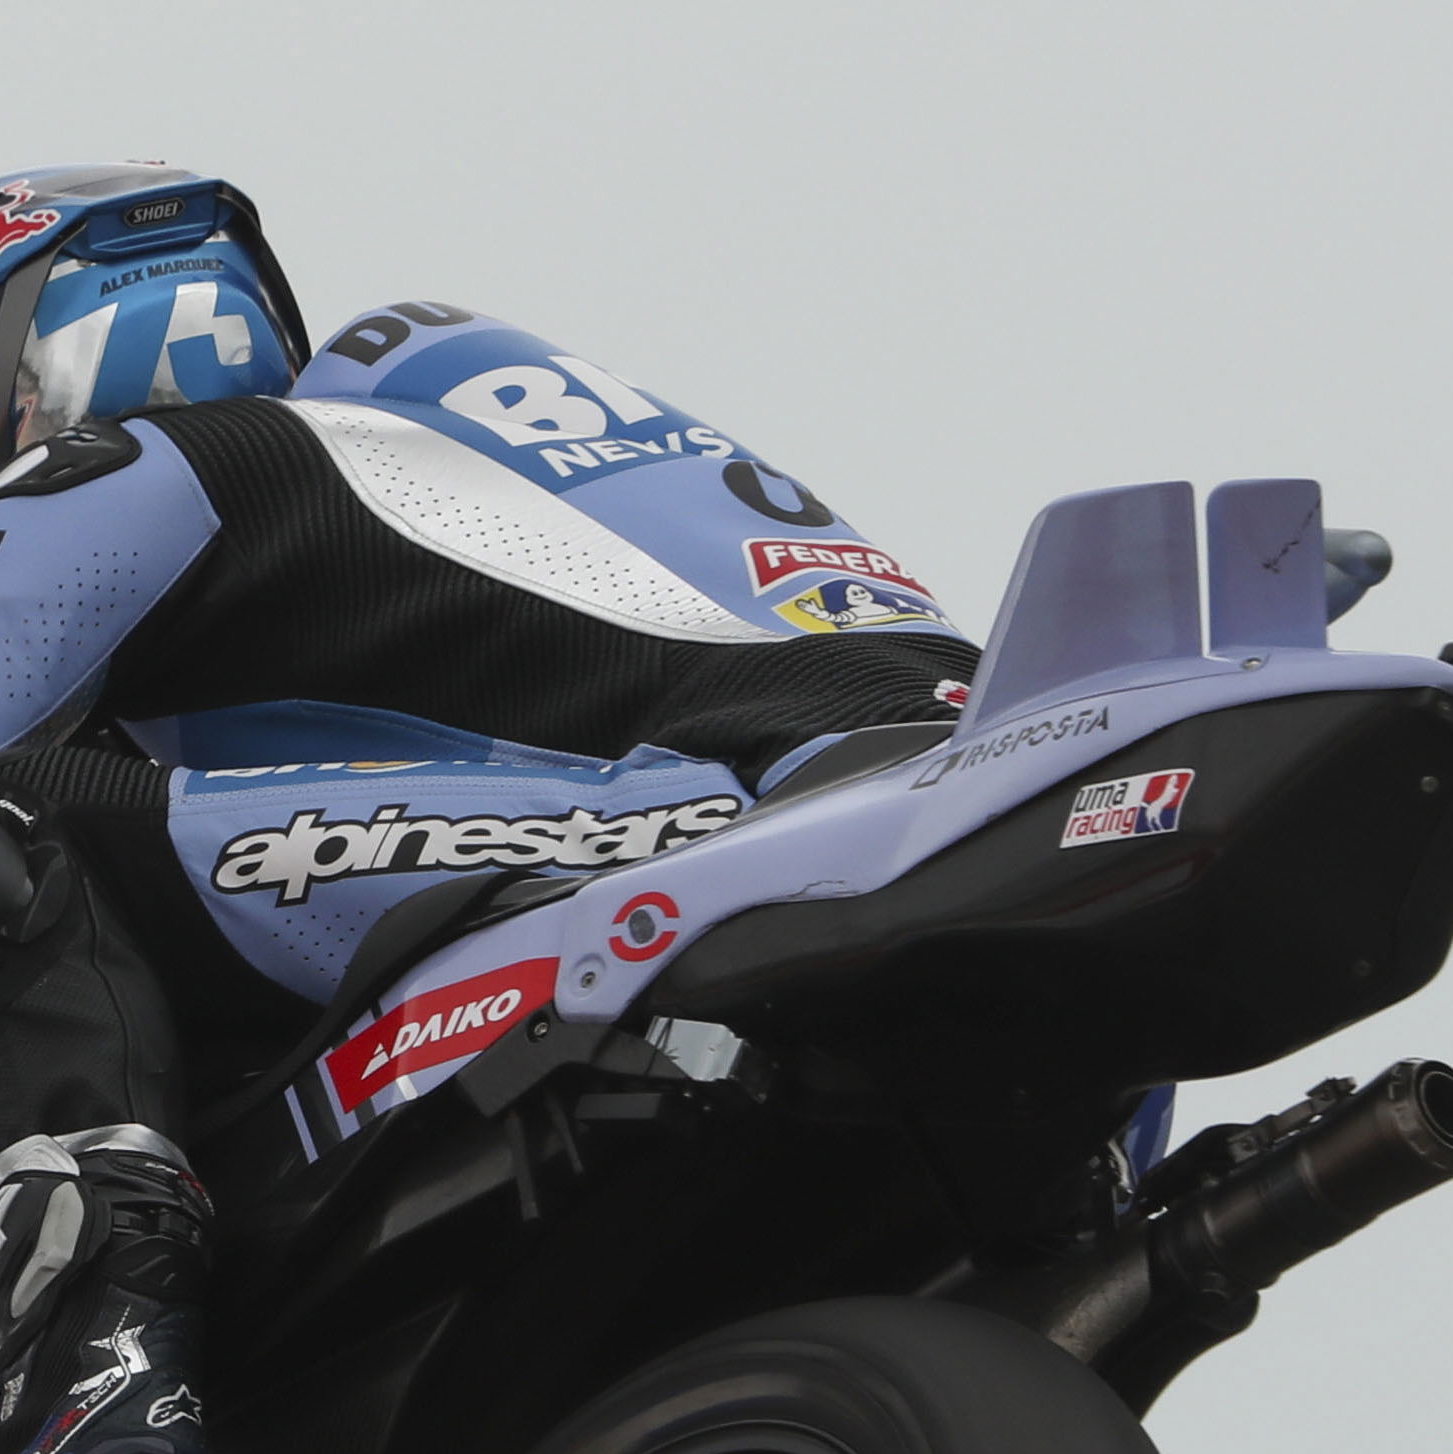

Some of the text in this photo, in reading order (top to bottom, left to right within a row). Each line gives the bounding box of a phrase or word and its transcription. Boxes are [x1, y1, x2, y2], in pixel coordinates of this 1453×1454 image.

[132, 202, 179, 224] SHOEI
[99, 268, 145, 298] ALEX
[961, 706, 1109, 771] RISPOSTA
[1073, 780, 1130, 812] uma
[1065, 806, 1140, 840] racing
[214, 797, 742, 901] alpinestars
[390, 988, 522, 1059] DAIKO
